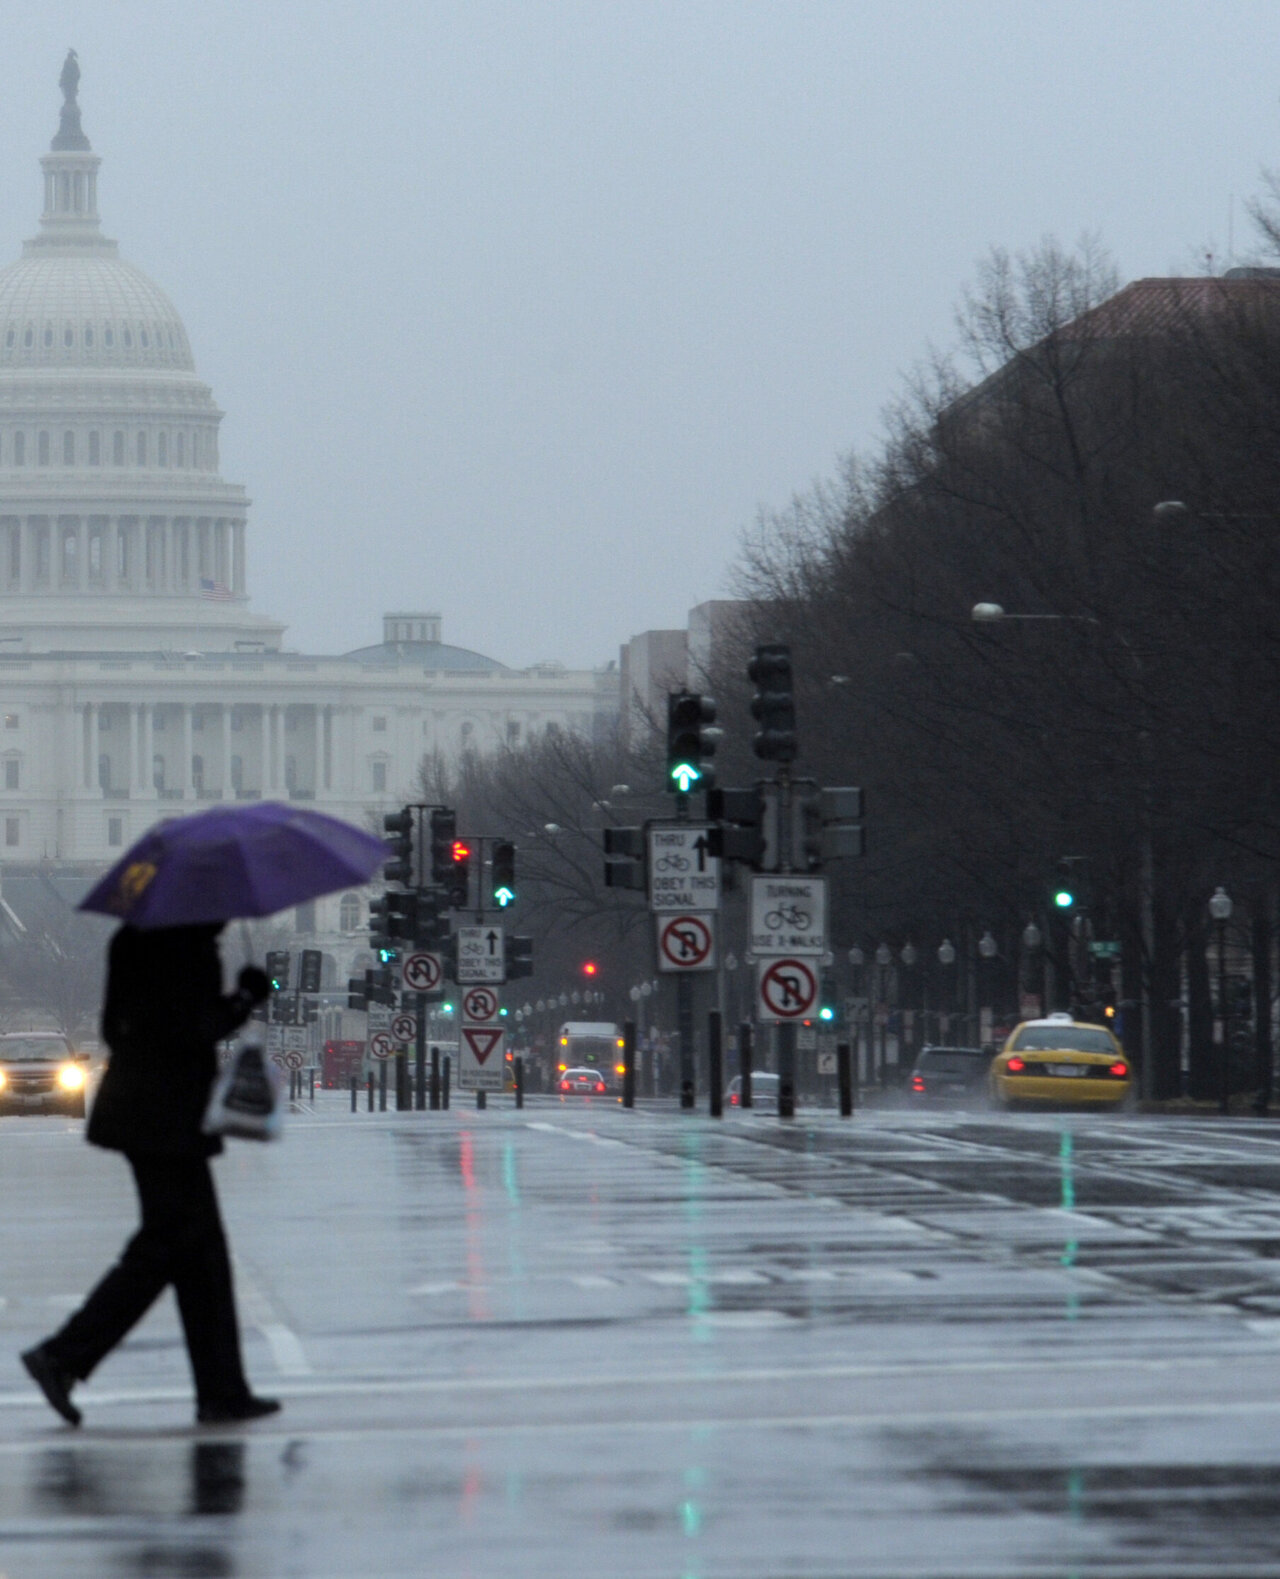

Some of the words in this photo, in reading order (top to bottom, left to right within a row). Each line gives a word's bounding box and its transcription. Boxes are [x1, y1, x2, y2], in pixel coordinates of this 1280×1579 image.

[654, 834, 686, 847] THRU
[654, 876, 685, 890] OBEY
[690, 876, 715, 889] THIS
[766, 884, 812, 898] TURNING
[654, 893, 695, 907] SIGNAL
